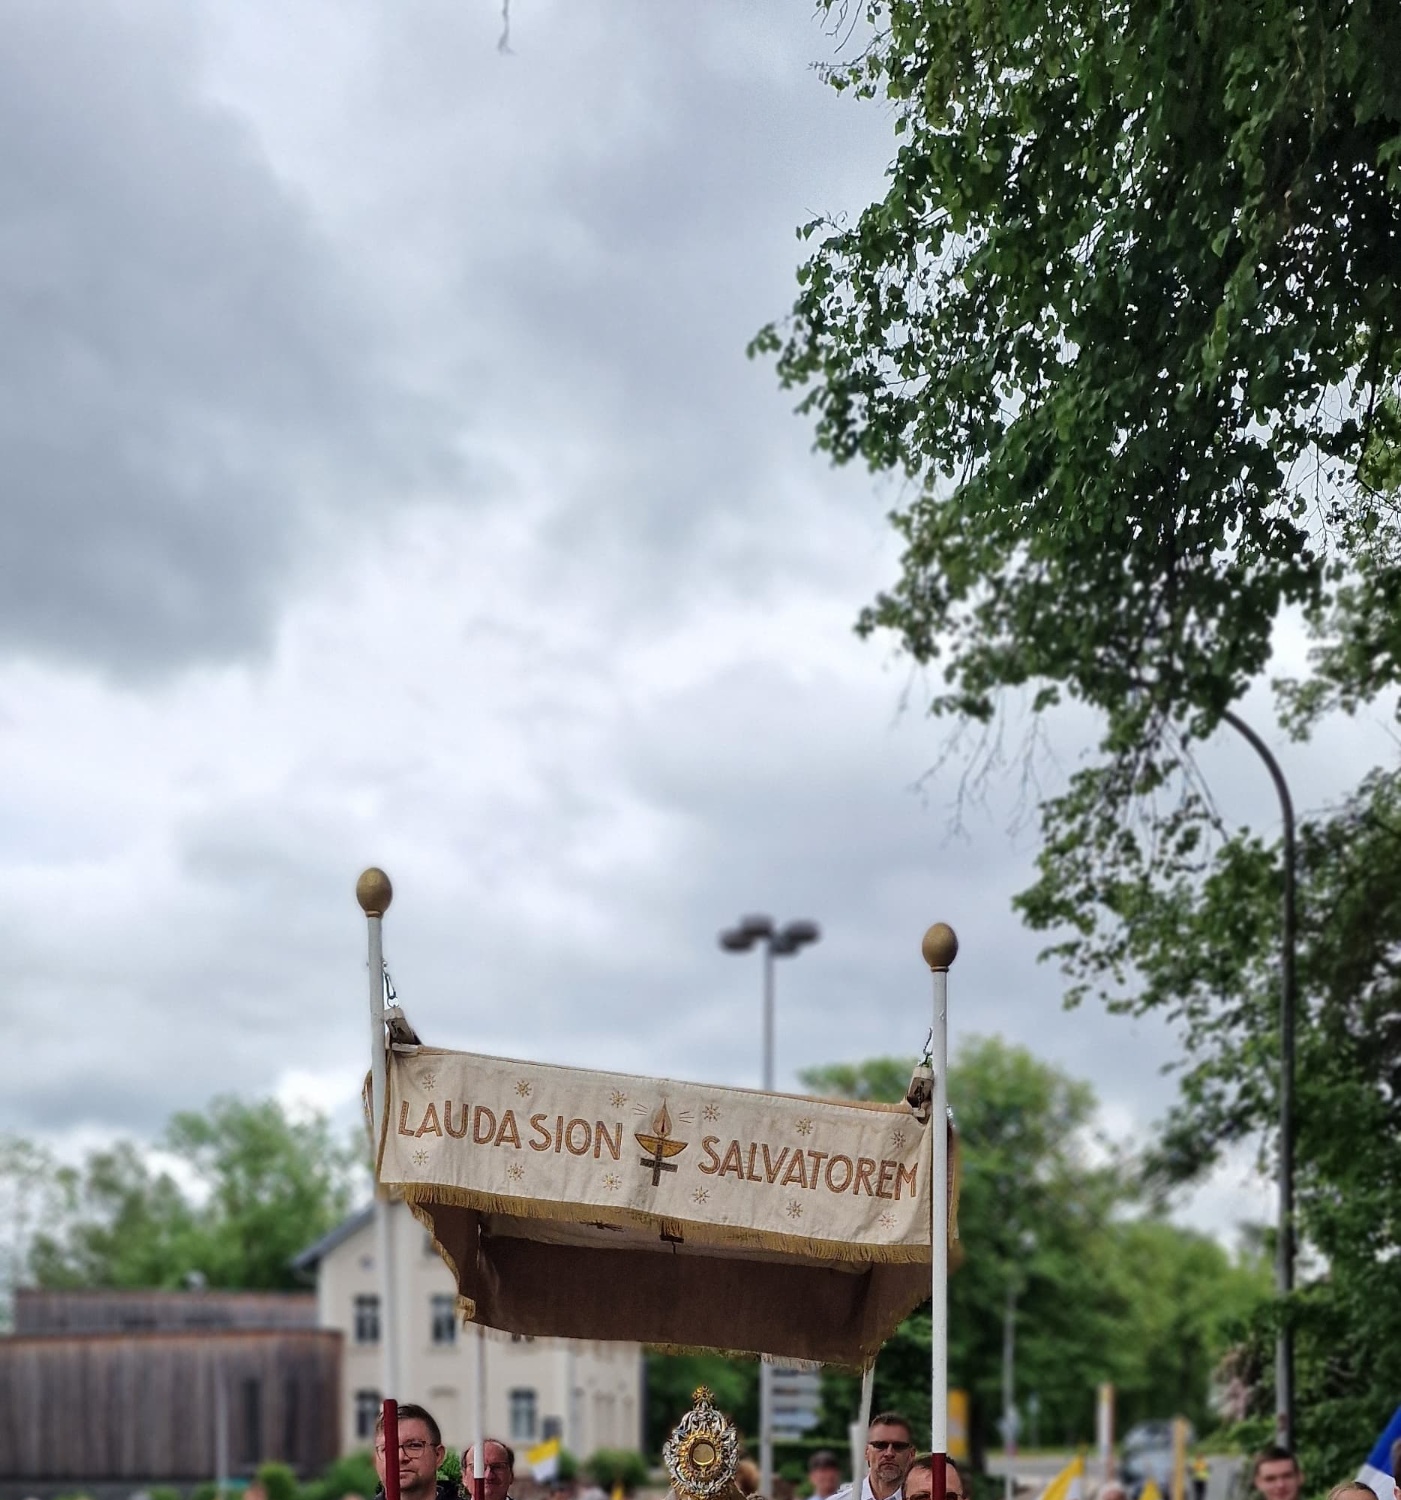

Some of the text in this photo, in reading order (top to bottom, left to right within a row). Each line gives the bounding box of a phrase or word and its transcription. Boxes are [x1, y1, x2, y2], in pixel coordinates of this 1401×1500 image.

[398, 1100, 919, 1201] LAUDA SION SALVATOREM
